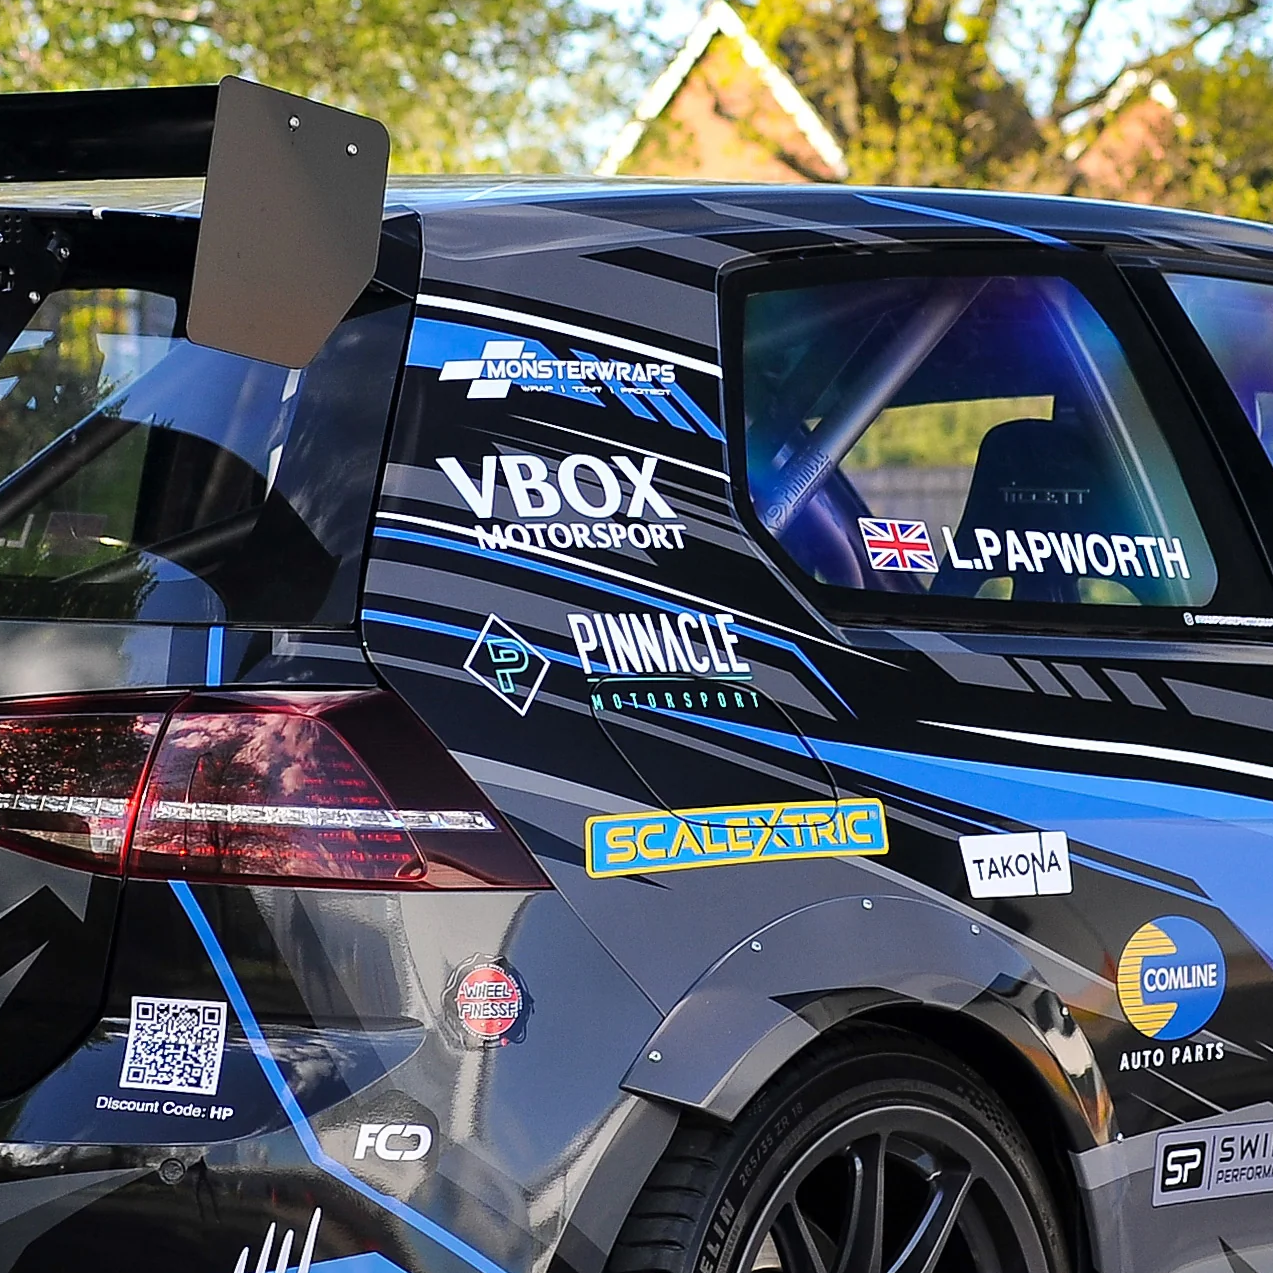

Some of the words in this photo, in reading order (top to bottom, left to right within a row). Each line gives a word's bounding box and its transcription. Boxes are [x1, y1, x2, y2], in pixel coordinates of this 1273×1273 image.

[486, 357, 677, 384] MONSTERWRAPS
[435, 452, 679, 520] VBOX
[473, 522, 688, 551] MOTORSPORT
[941, 525, 1192, 580] L.PAPWORTH
[566, 611, 752, 676] PINNACLE
[590, 691, 761, 711] MOTORSPORT
[603, 808, 878, 864] SCALEXTRIC
[971, 849, 1062, 883] TAKONA
[463, 981, 512, 1000] WHEEL
[1142, 963, 1218, 991] COMLINE
[1119, 1047, 1167, 1072] AUTO
[1171, 1041, 1226, 1067] PARTS
[95, 1096, 159, 1115] Discount
[162, 1101, 207, 1119] Code:
[209, 1105, 234, 1121] HP
[1164, 1148, 1202, 1186] SP
